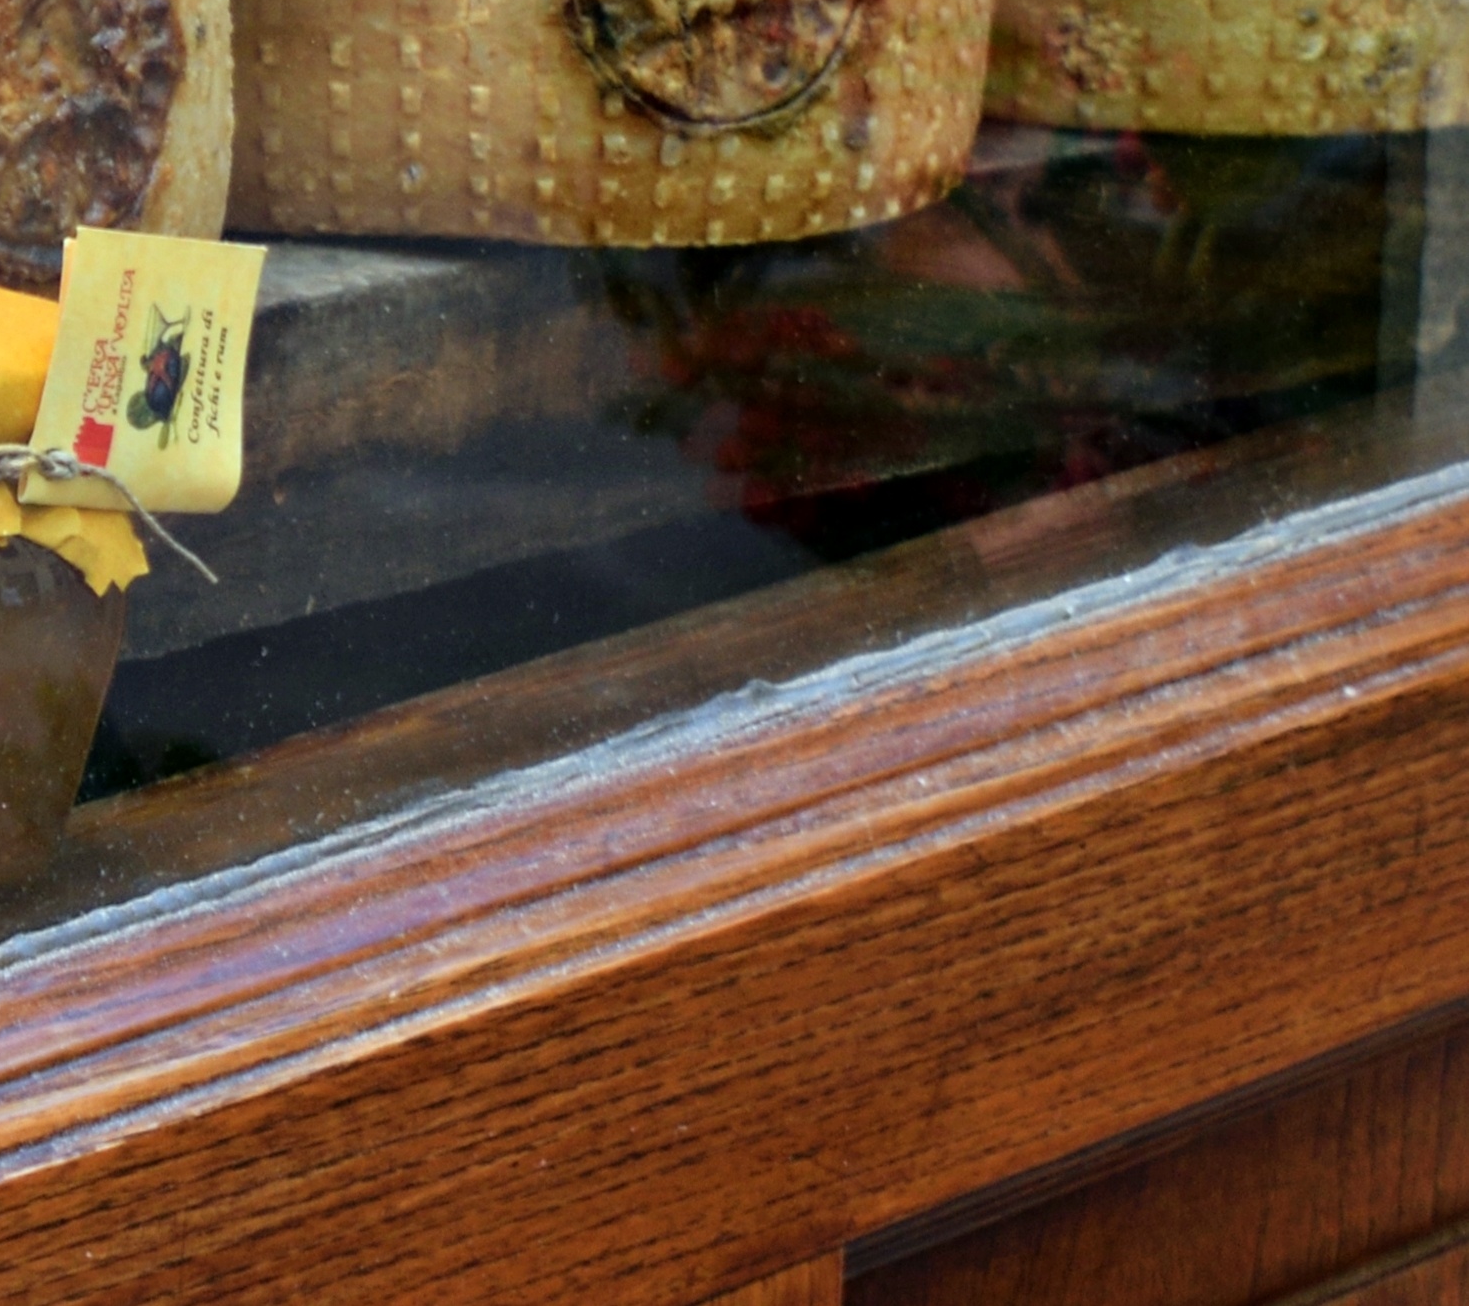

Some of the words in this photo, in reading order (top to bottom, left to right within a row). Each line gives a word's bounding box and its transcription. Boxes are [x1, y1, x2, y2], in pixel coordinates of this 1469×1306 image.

[82, 337, 108, 413] C'ERA
[96, 355, 120, 416] UNA
[110, 268, 136, 352] VOLTA
[184, 335, 214, 444] Confettura
[200, 309, 214, 330] di
[203, 386, 224, 437] fichi
[214, 326, 229, 365] rum
